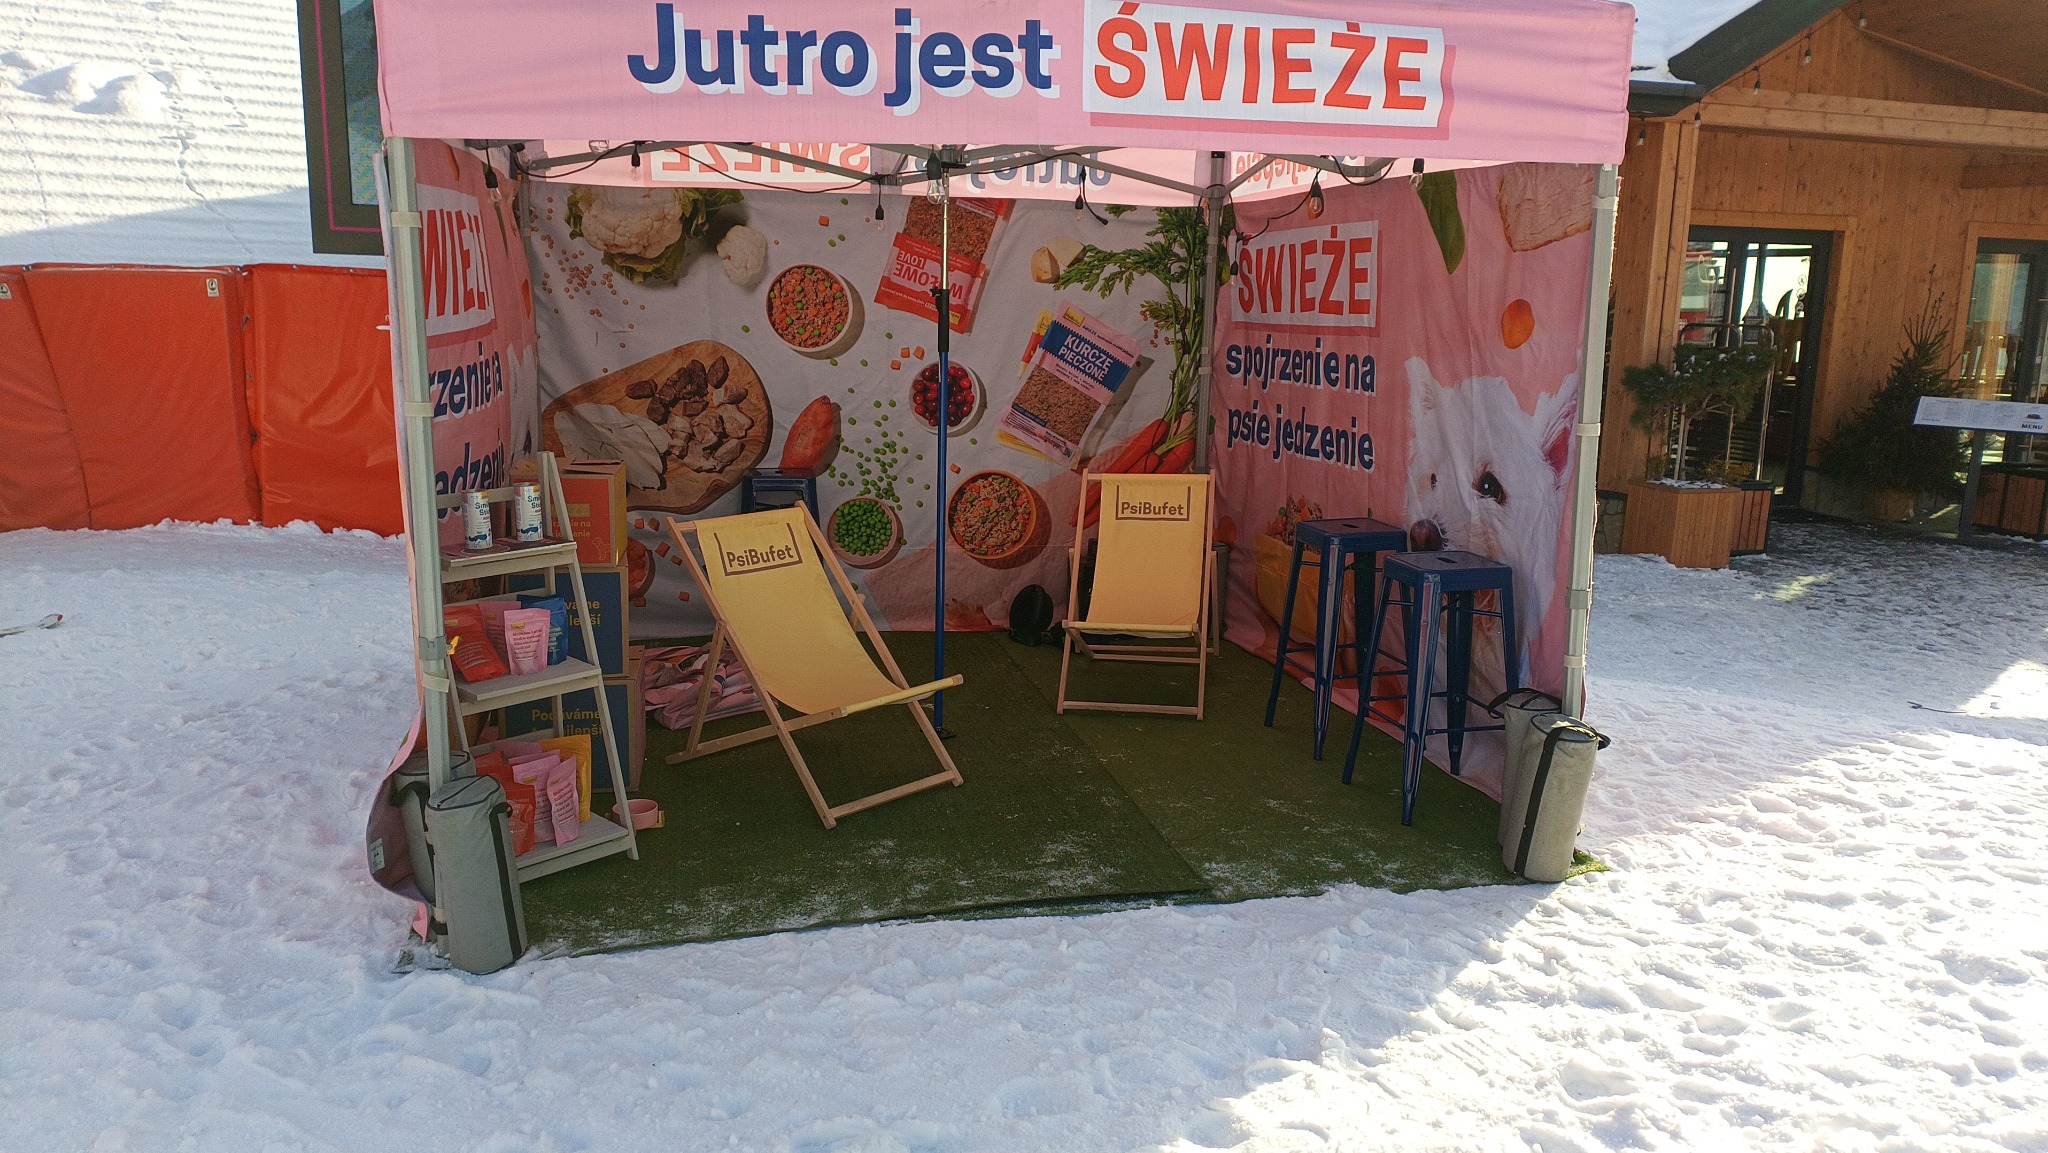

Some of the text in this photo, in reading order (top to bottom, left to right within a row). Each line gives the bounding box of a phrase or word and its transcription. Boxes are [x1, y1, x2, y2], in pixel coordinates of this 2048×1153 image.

[627, 2, 1428, 111] Jutro jest ŚWIEŻE
[898, 250, 927, 270] LOVE
[1238, 224, 1373, 316] ŚWIEŻE
[893, 261, 964, 301] WŁOWE
[1058, 346, 1106, 381] PIECZONE
[1064, 334, 1113, 374] KURCZĘ
[1225, 334, 1376, 392] spojrzenie na
[1227, 400, 1374, 470] psie jedzenie
[1120, 501, 1184, 516] PsiBufet
[726, 544, 794, 568] PsiBufet
